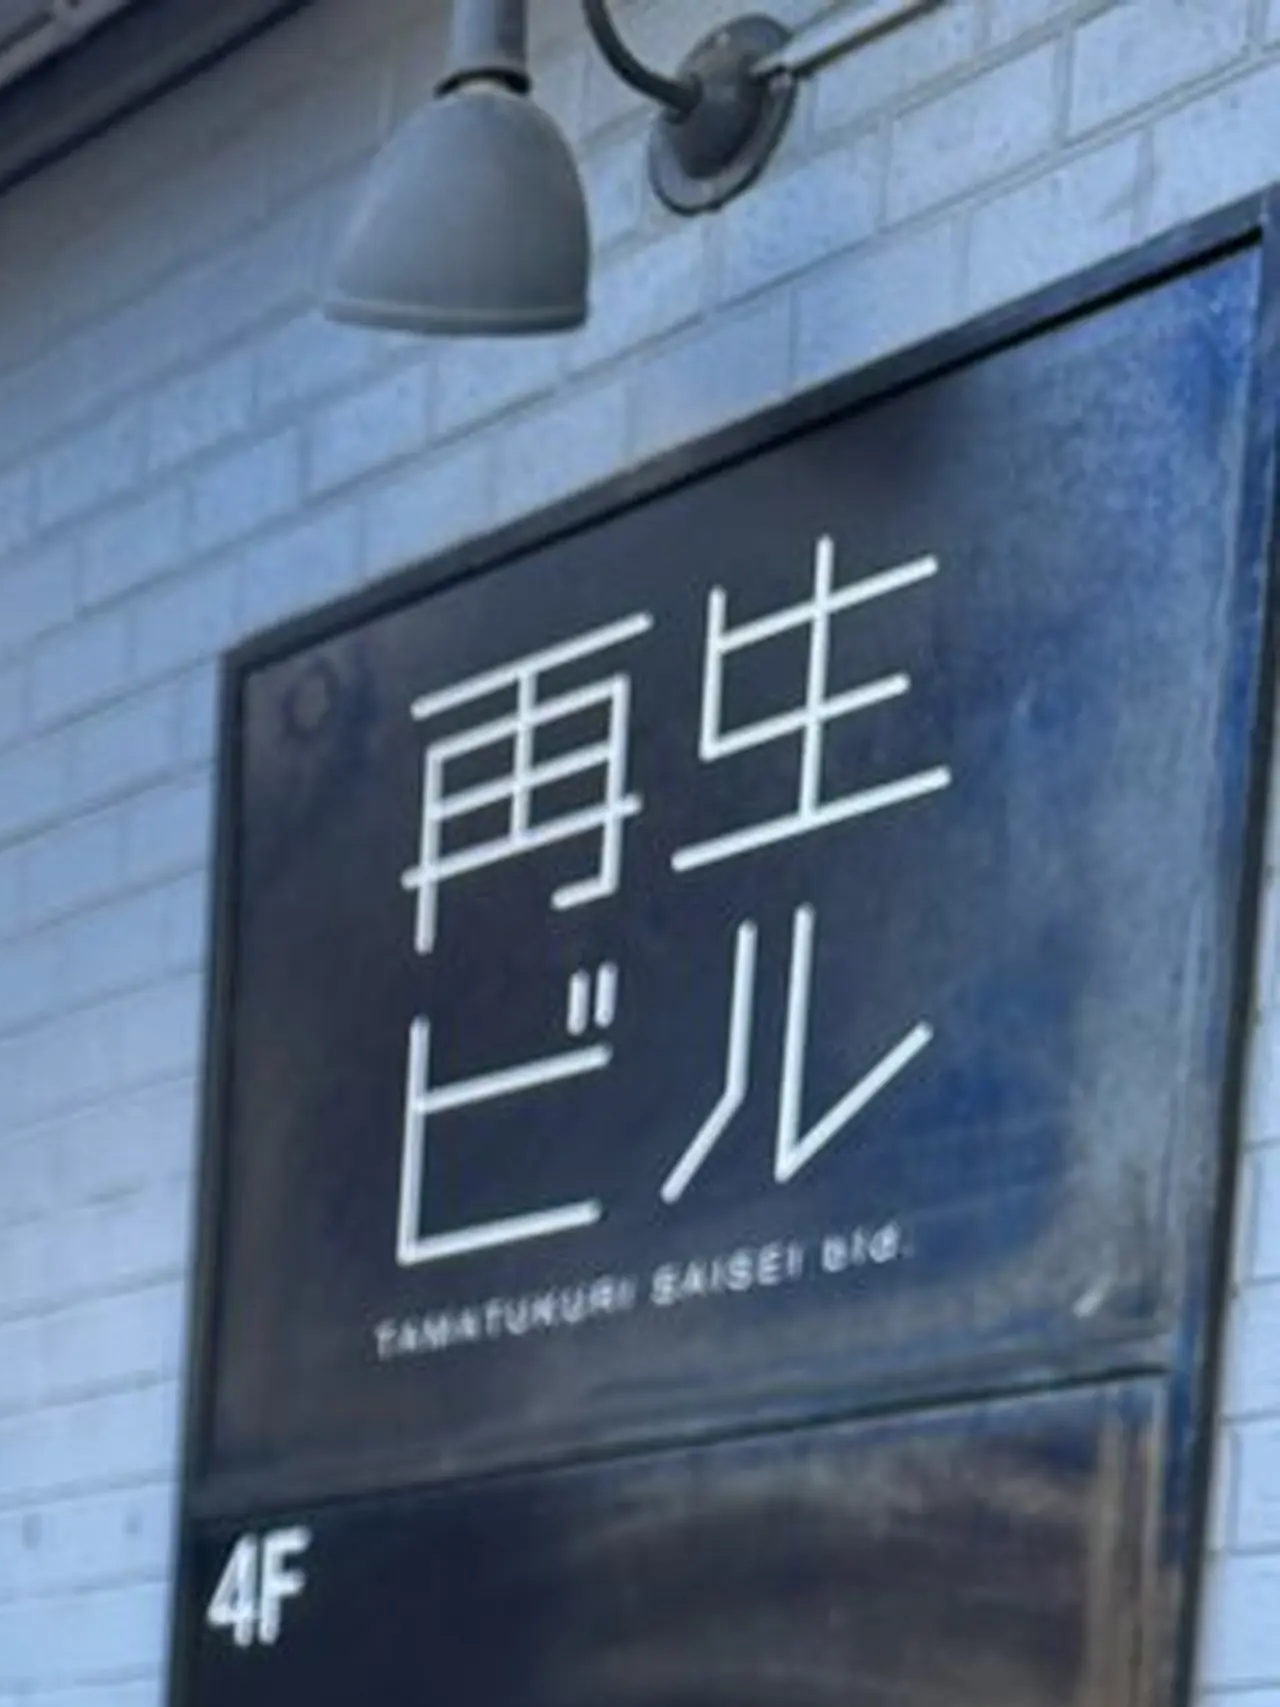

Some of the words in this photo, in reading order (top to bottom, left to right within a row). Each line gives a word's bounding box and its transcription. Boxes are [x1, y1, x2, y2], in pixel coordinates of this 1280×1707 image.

[400, 534, 952, 954] 再生
[394, 900, 936, 1268] ビル
[205, 1524, 312, 1647] 4F
